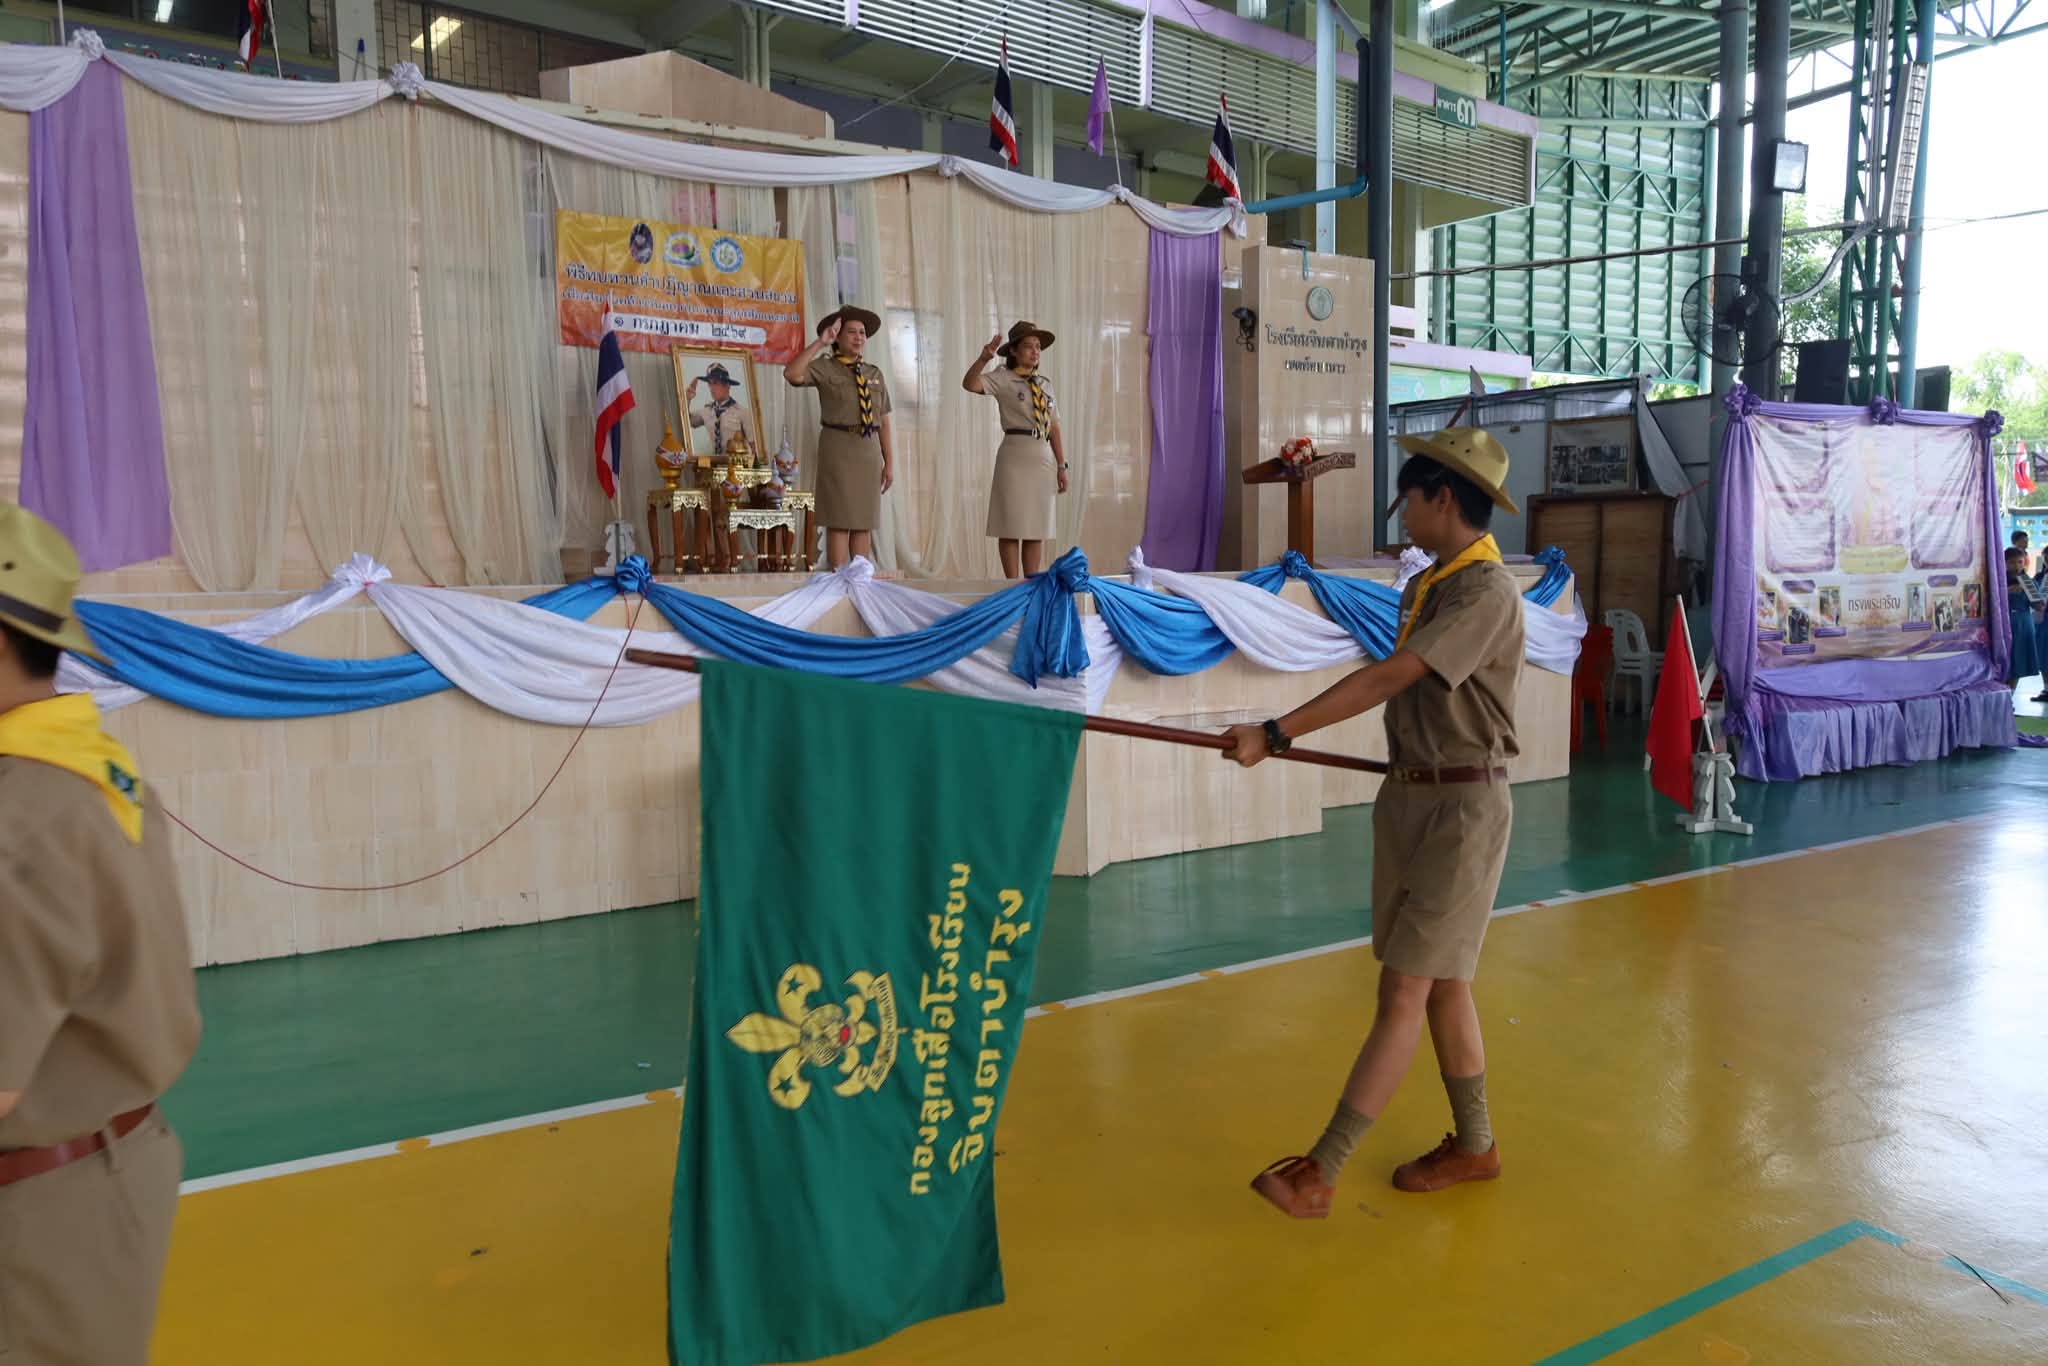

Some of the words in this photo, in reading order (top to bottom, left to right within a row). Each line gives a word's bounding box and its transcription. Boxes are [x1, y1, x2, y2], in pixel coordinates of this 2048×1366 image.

[1456, 96, 1476, 127] ๓
[614, 316, 624, 328] ๑
[632, 317, 700, 336] กรกฎาคม
[1848, 594, 1901, 612] ทรงพระเจริญ
[907, 861, 974, 1196] กองลูกเสือโรงเรียน
[948, 888, 1032, 1175] จินดาบำรุง
